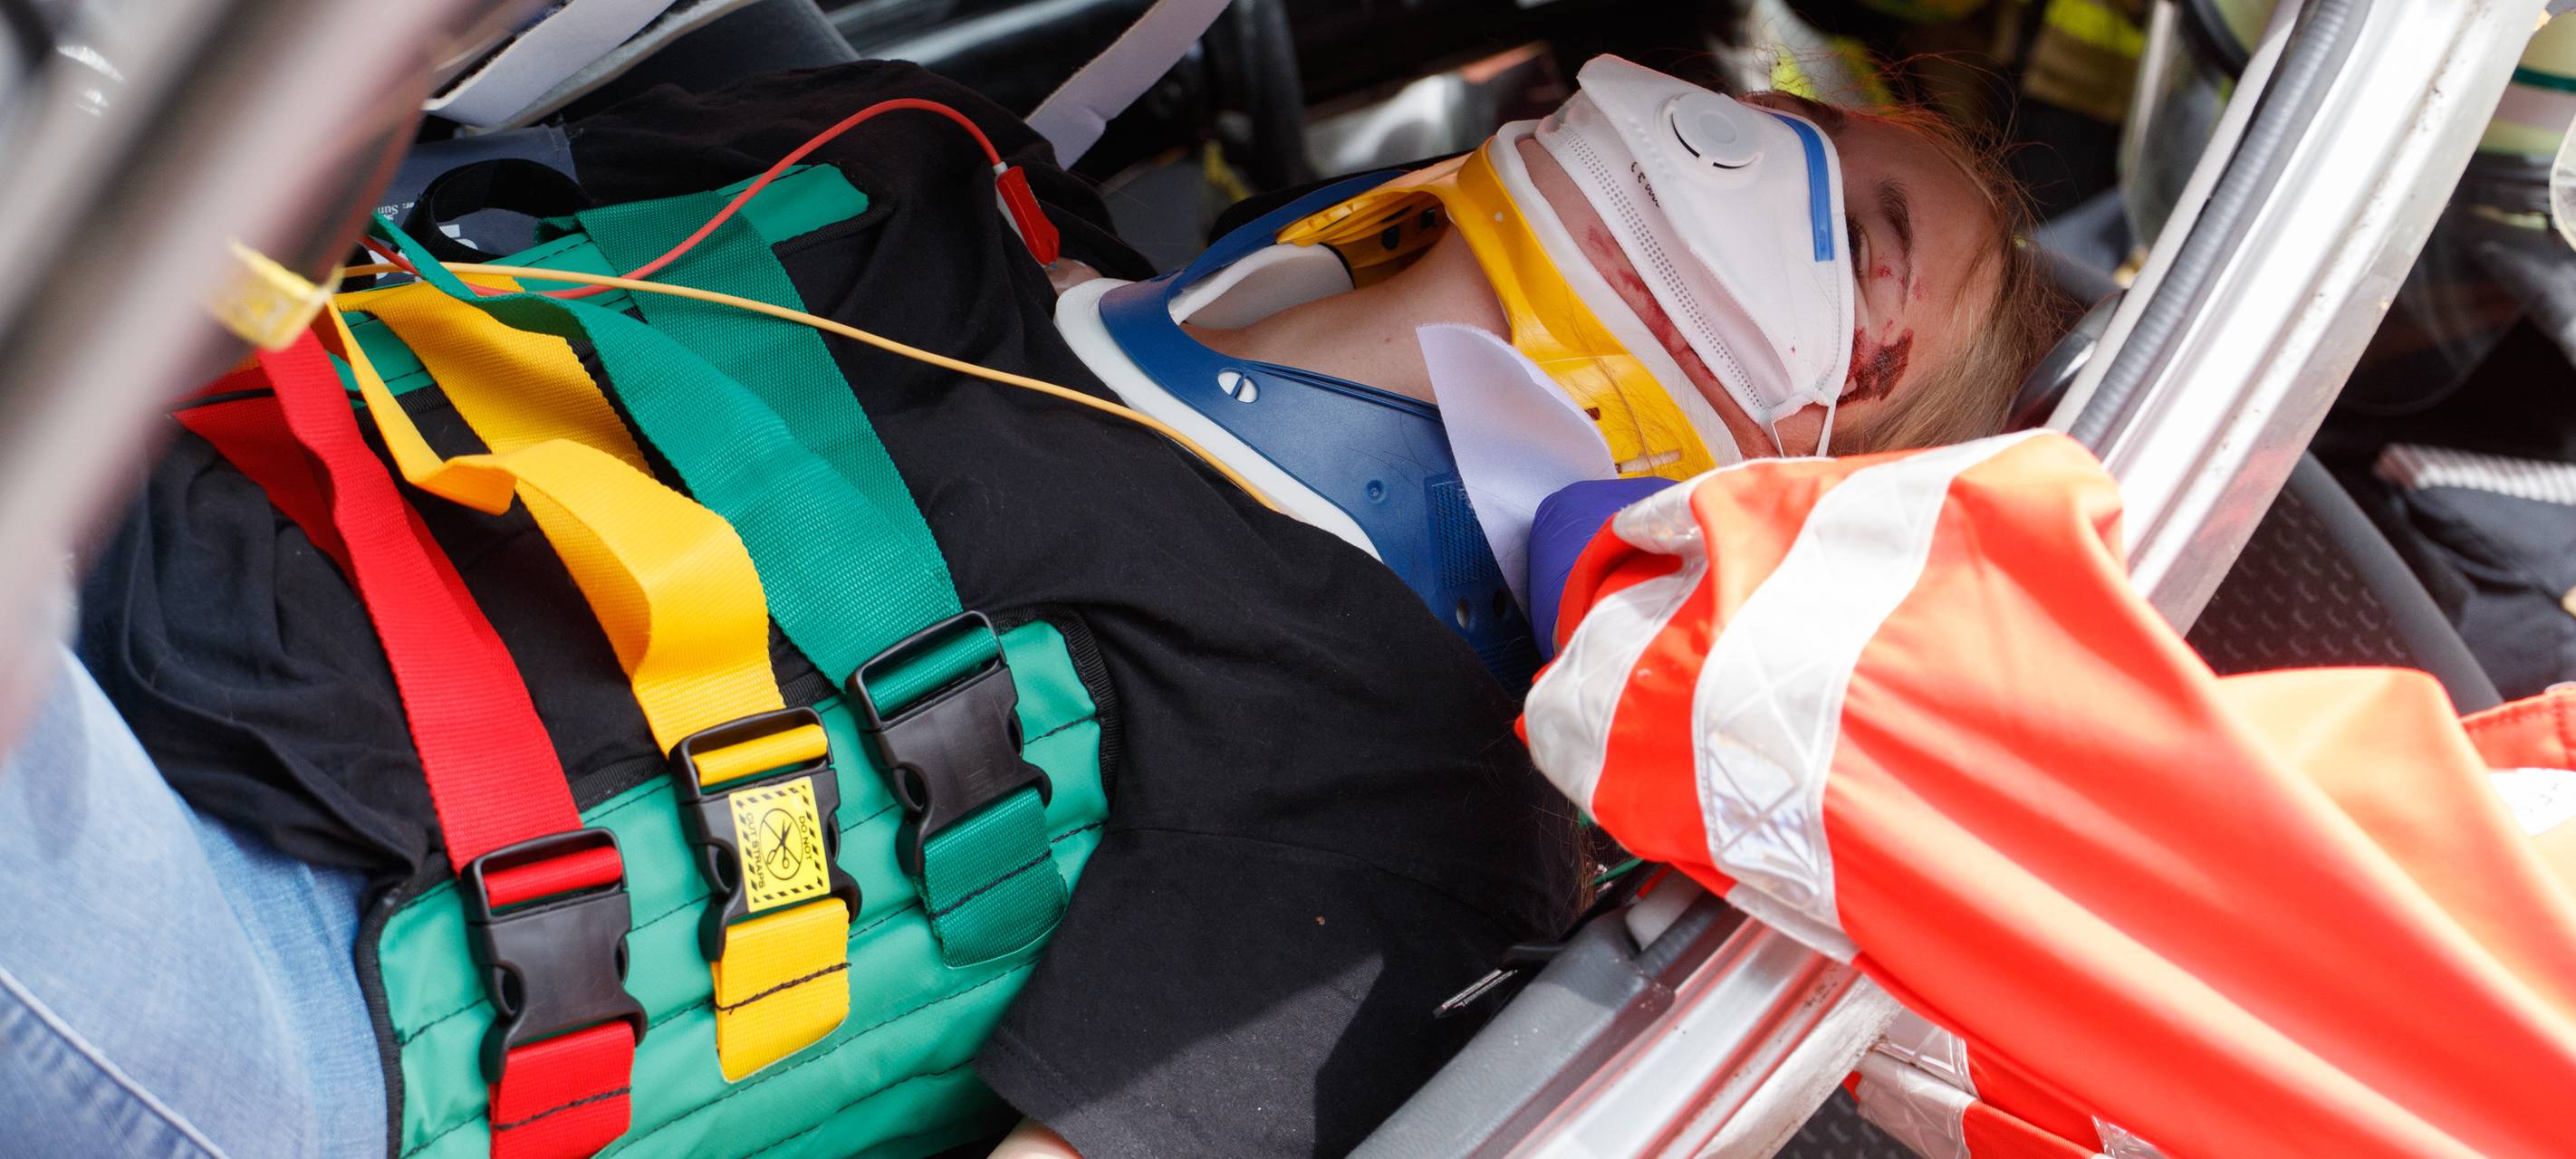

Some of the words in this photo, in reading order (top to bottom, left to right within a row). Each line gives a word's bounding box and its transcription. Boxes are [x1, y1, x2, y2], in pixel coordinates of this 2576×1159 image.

[745, 812, 757, 837] CUT
[751, 840, 766, 888] STRAPS
[798, 815, 808, 834] DO
[803, 837, 813, 860] NOT
